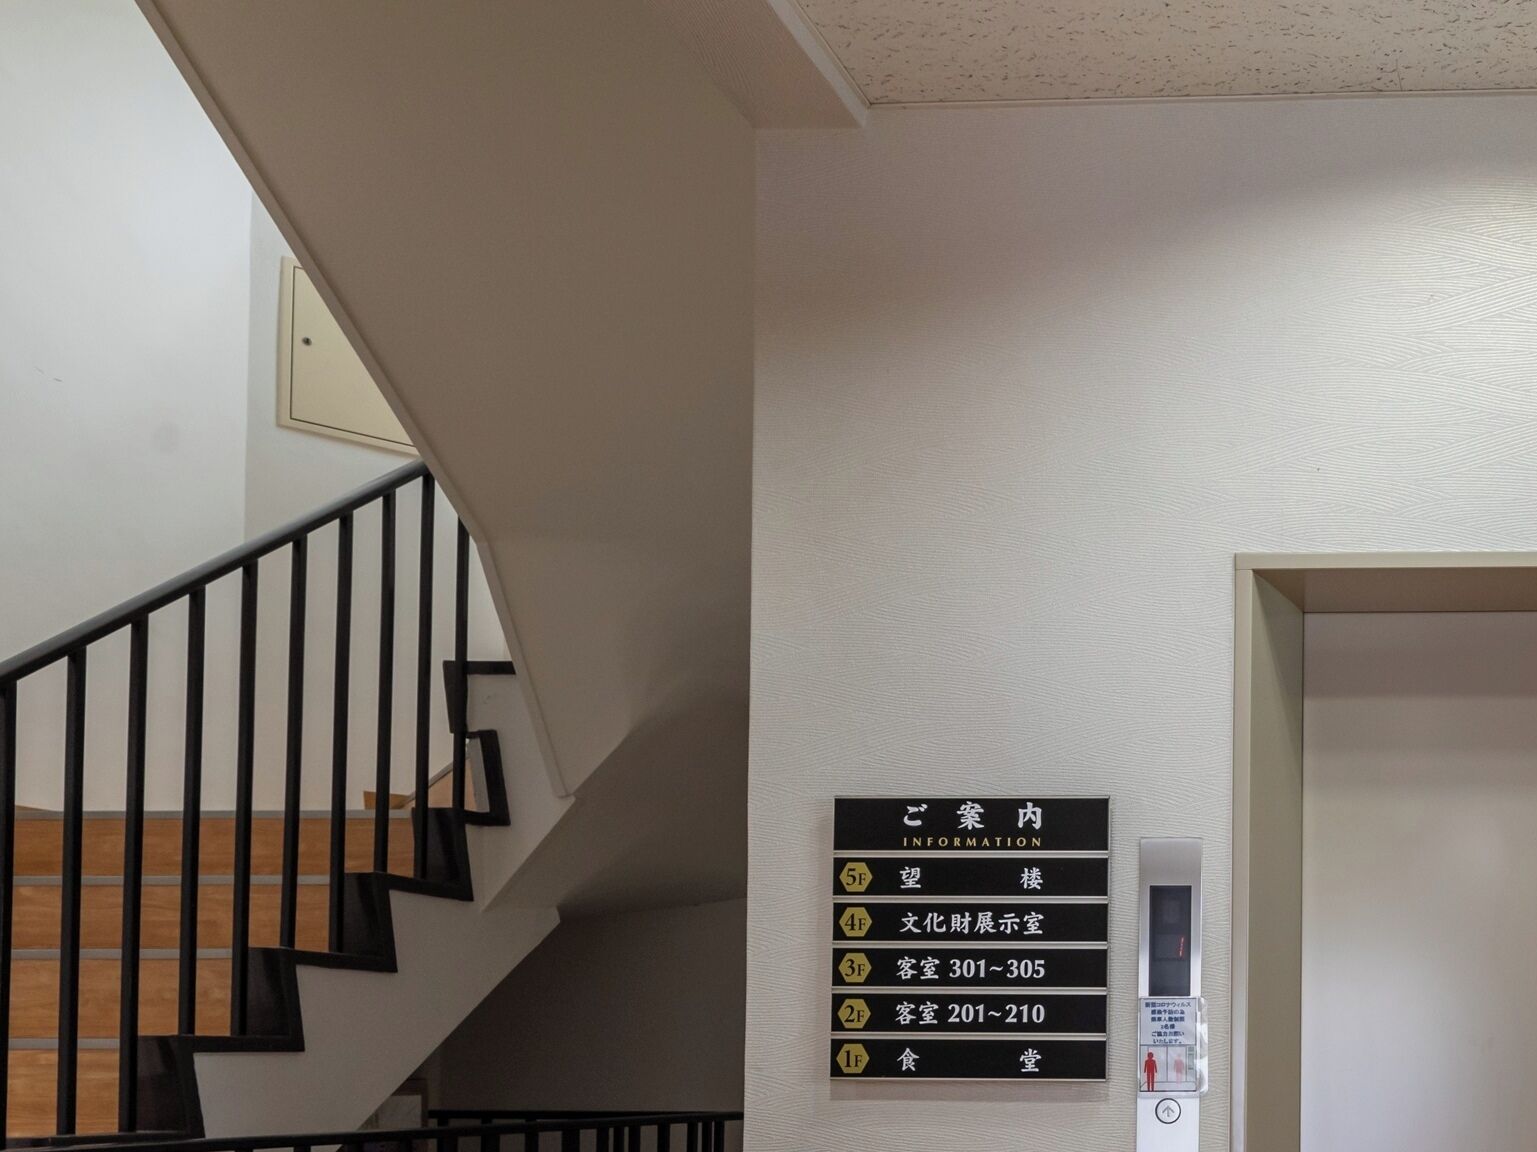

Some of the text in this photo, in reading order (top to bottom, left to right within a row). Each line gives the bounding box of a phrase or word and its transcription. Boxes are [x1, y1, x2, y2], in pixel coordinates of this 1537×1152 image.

[903, 801, 1042, 830] ご案内
[903, 836, 1041, 847] INFORMATION
[845, 867, 866, 886] 5F
[844, 911, 1044, 935] 4F 文化財展示室
[844, 958, 865, 977] 3F
[896, 956, 940, 980] 客室
[843, 1004, 864, 1023] 2F
[895, 1001, 939, 1025] 客室
[843, 1050, 863, 1068] 1F
